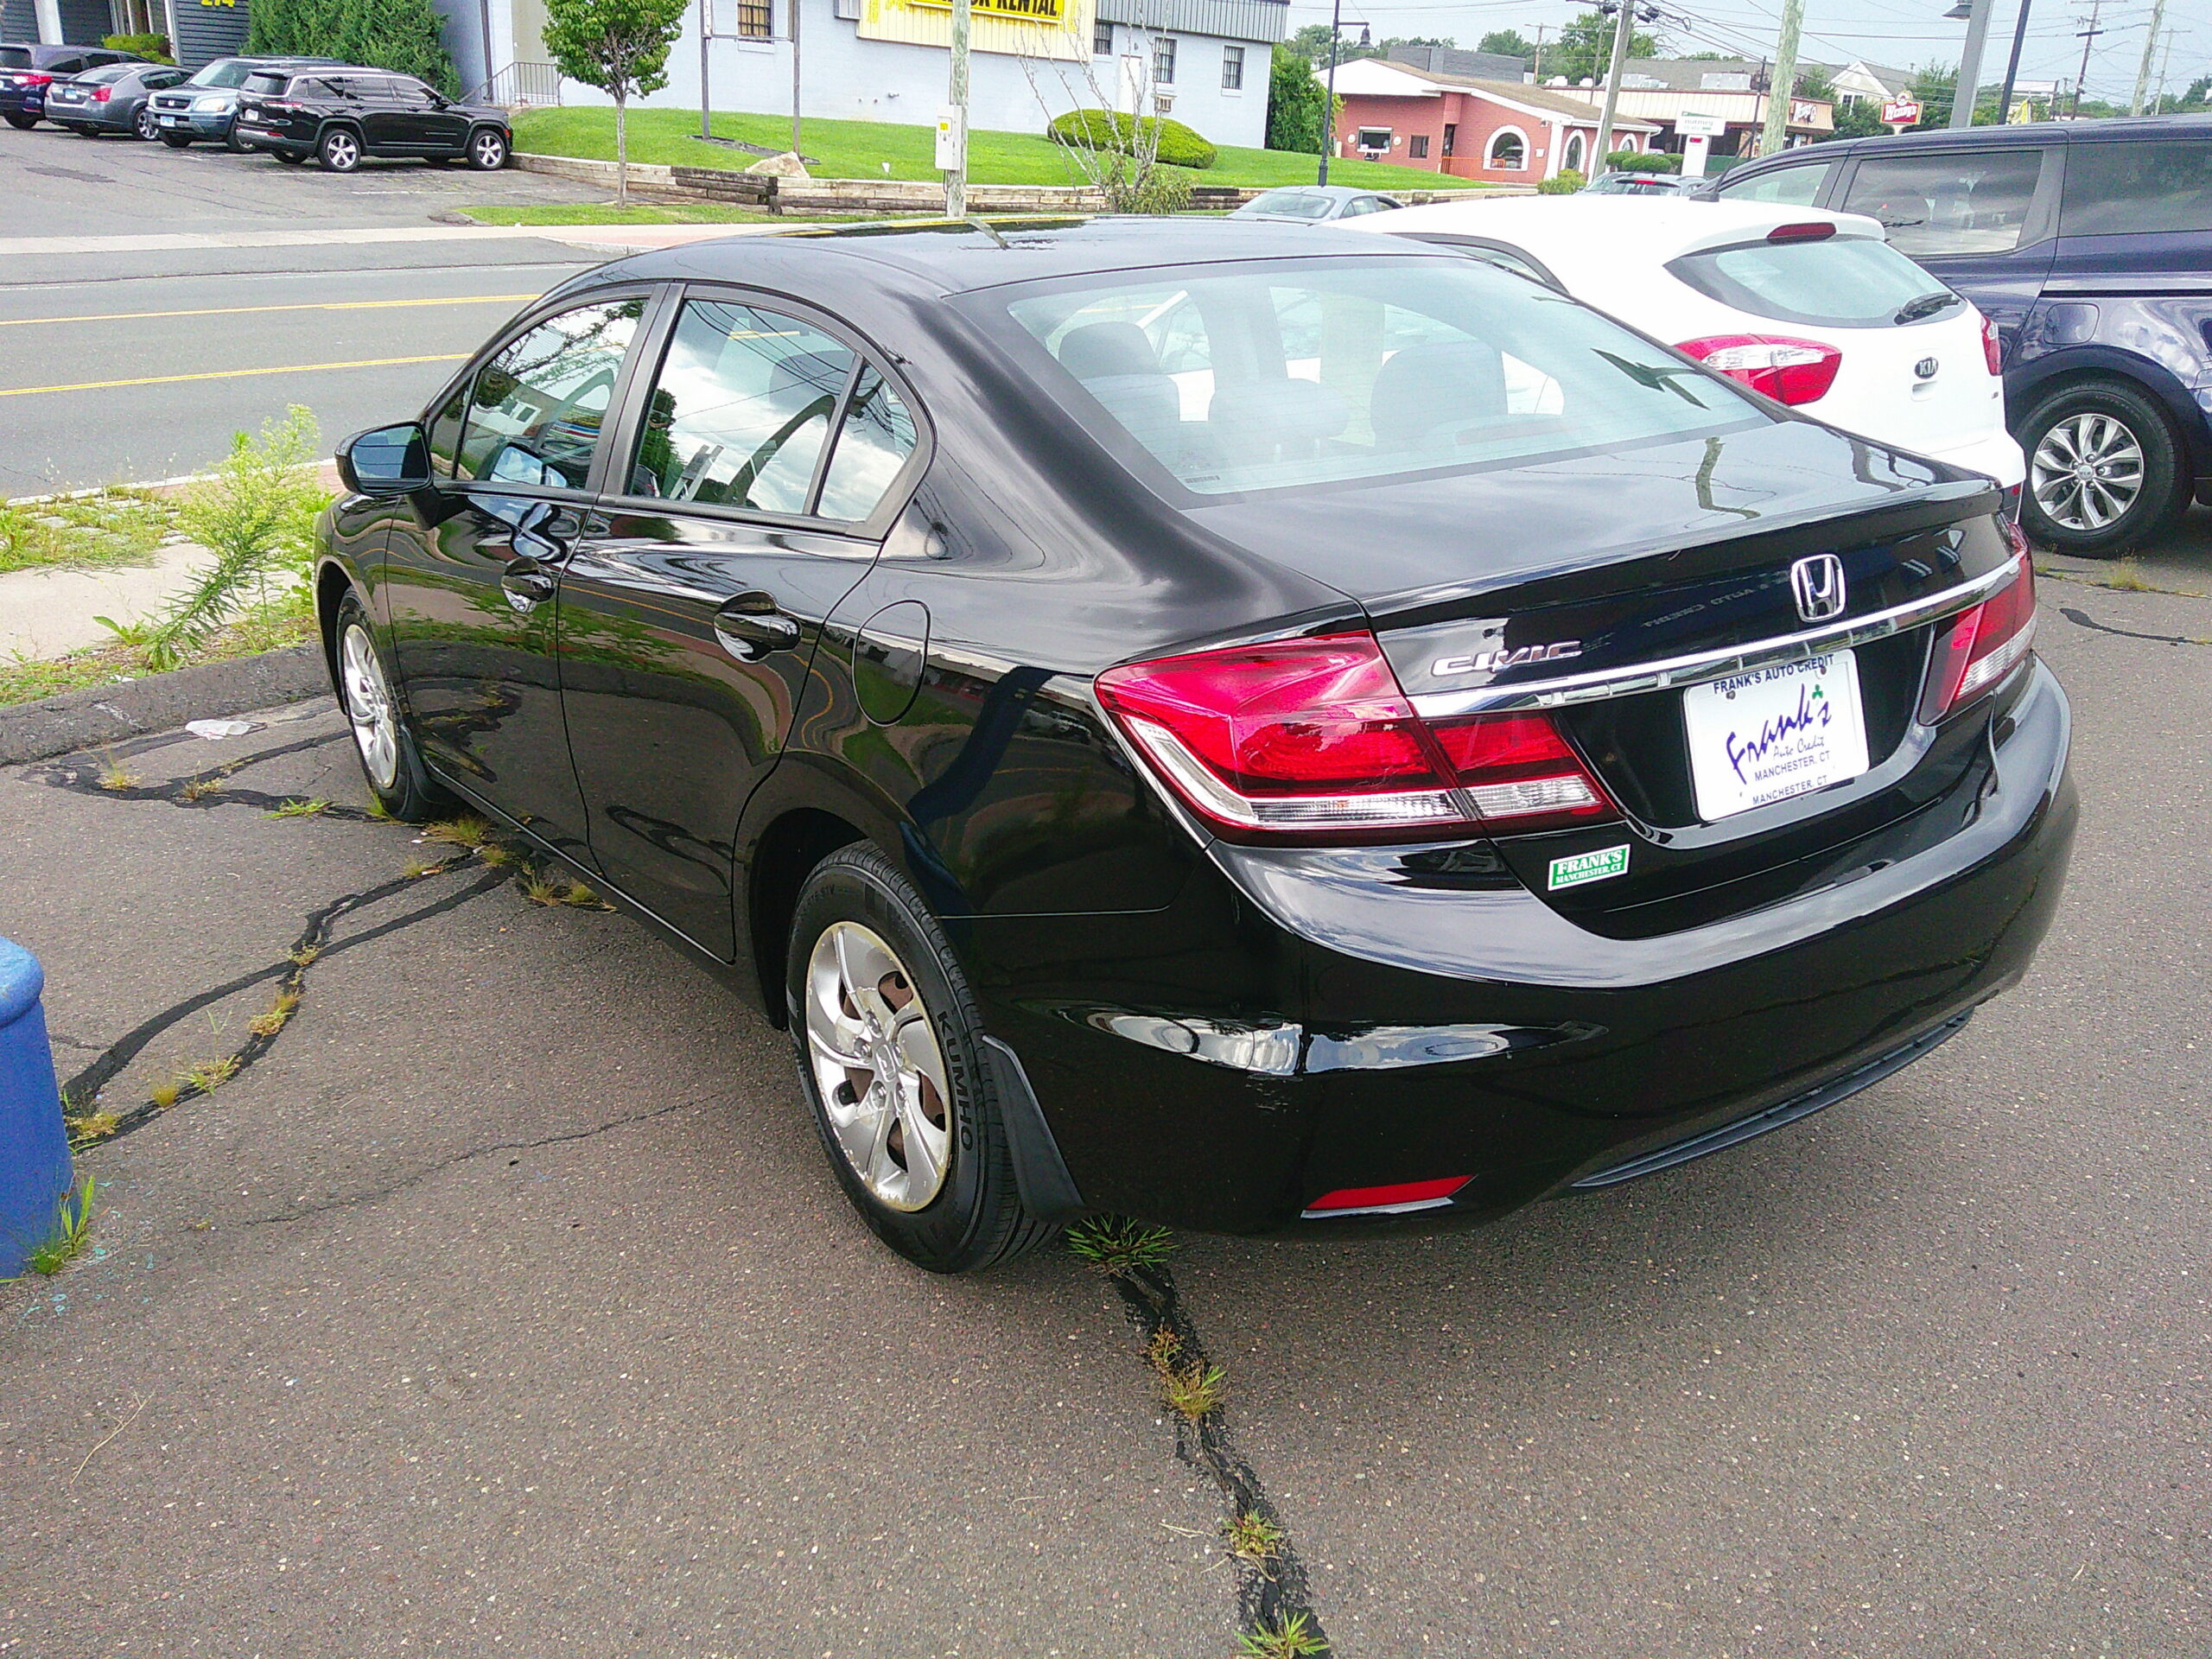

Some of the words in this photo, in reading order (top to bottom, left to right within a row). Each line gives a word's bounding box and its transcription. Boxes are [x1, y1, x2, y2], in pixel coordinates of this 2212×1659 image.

[1919, 359, 1936, 375] KIA
[1431, 640, 1583, 677] CIVIC
[1713, 674, 1762, 695] FRANK'S
[1764, 664, 1795, 683] AUTO
[1797, 653, 1835, 673] CREDIT
[1772, 745, 1795, 760] Auto
[1796, 734, 1826, 754] Credit
[1819, 750, 1830, 762] CT
[1816, 774, 1827, 785] CT
[1556, 849, 1623, 874] FRANK'S
[1610, 862, 1623, 872] CT
[937, 1010, 974, 1152] KUMHO
